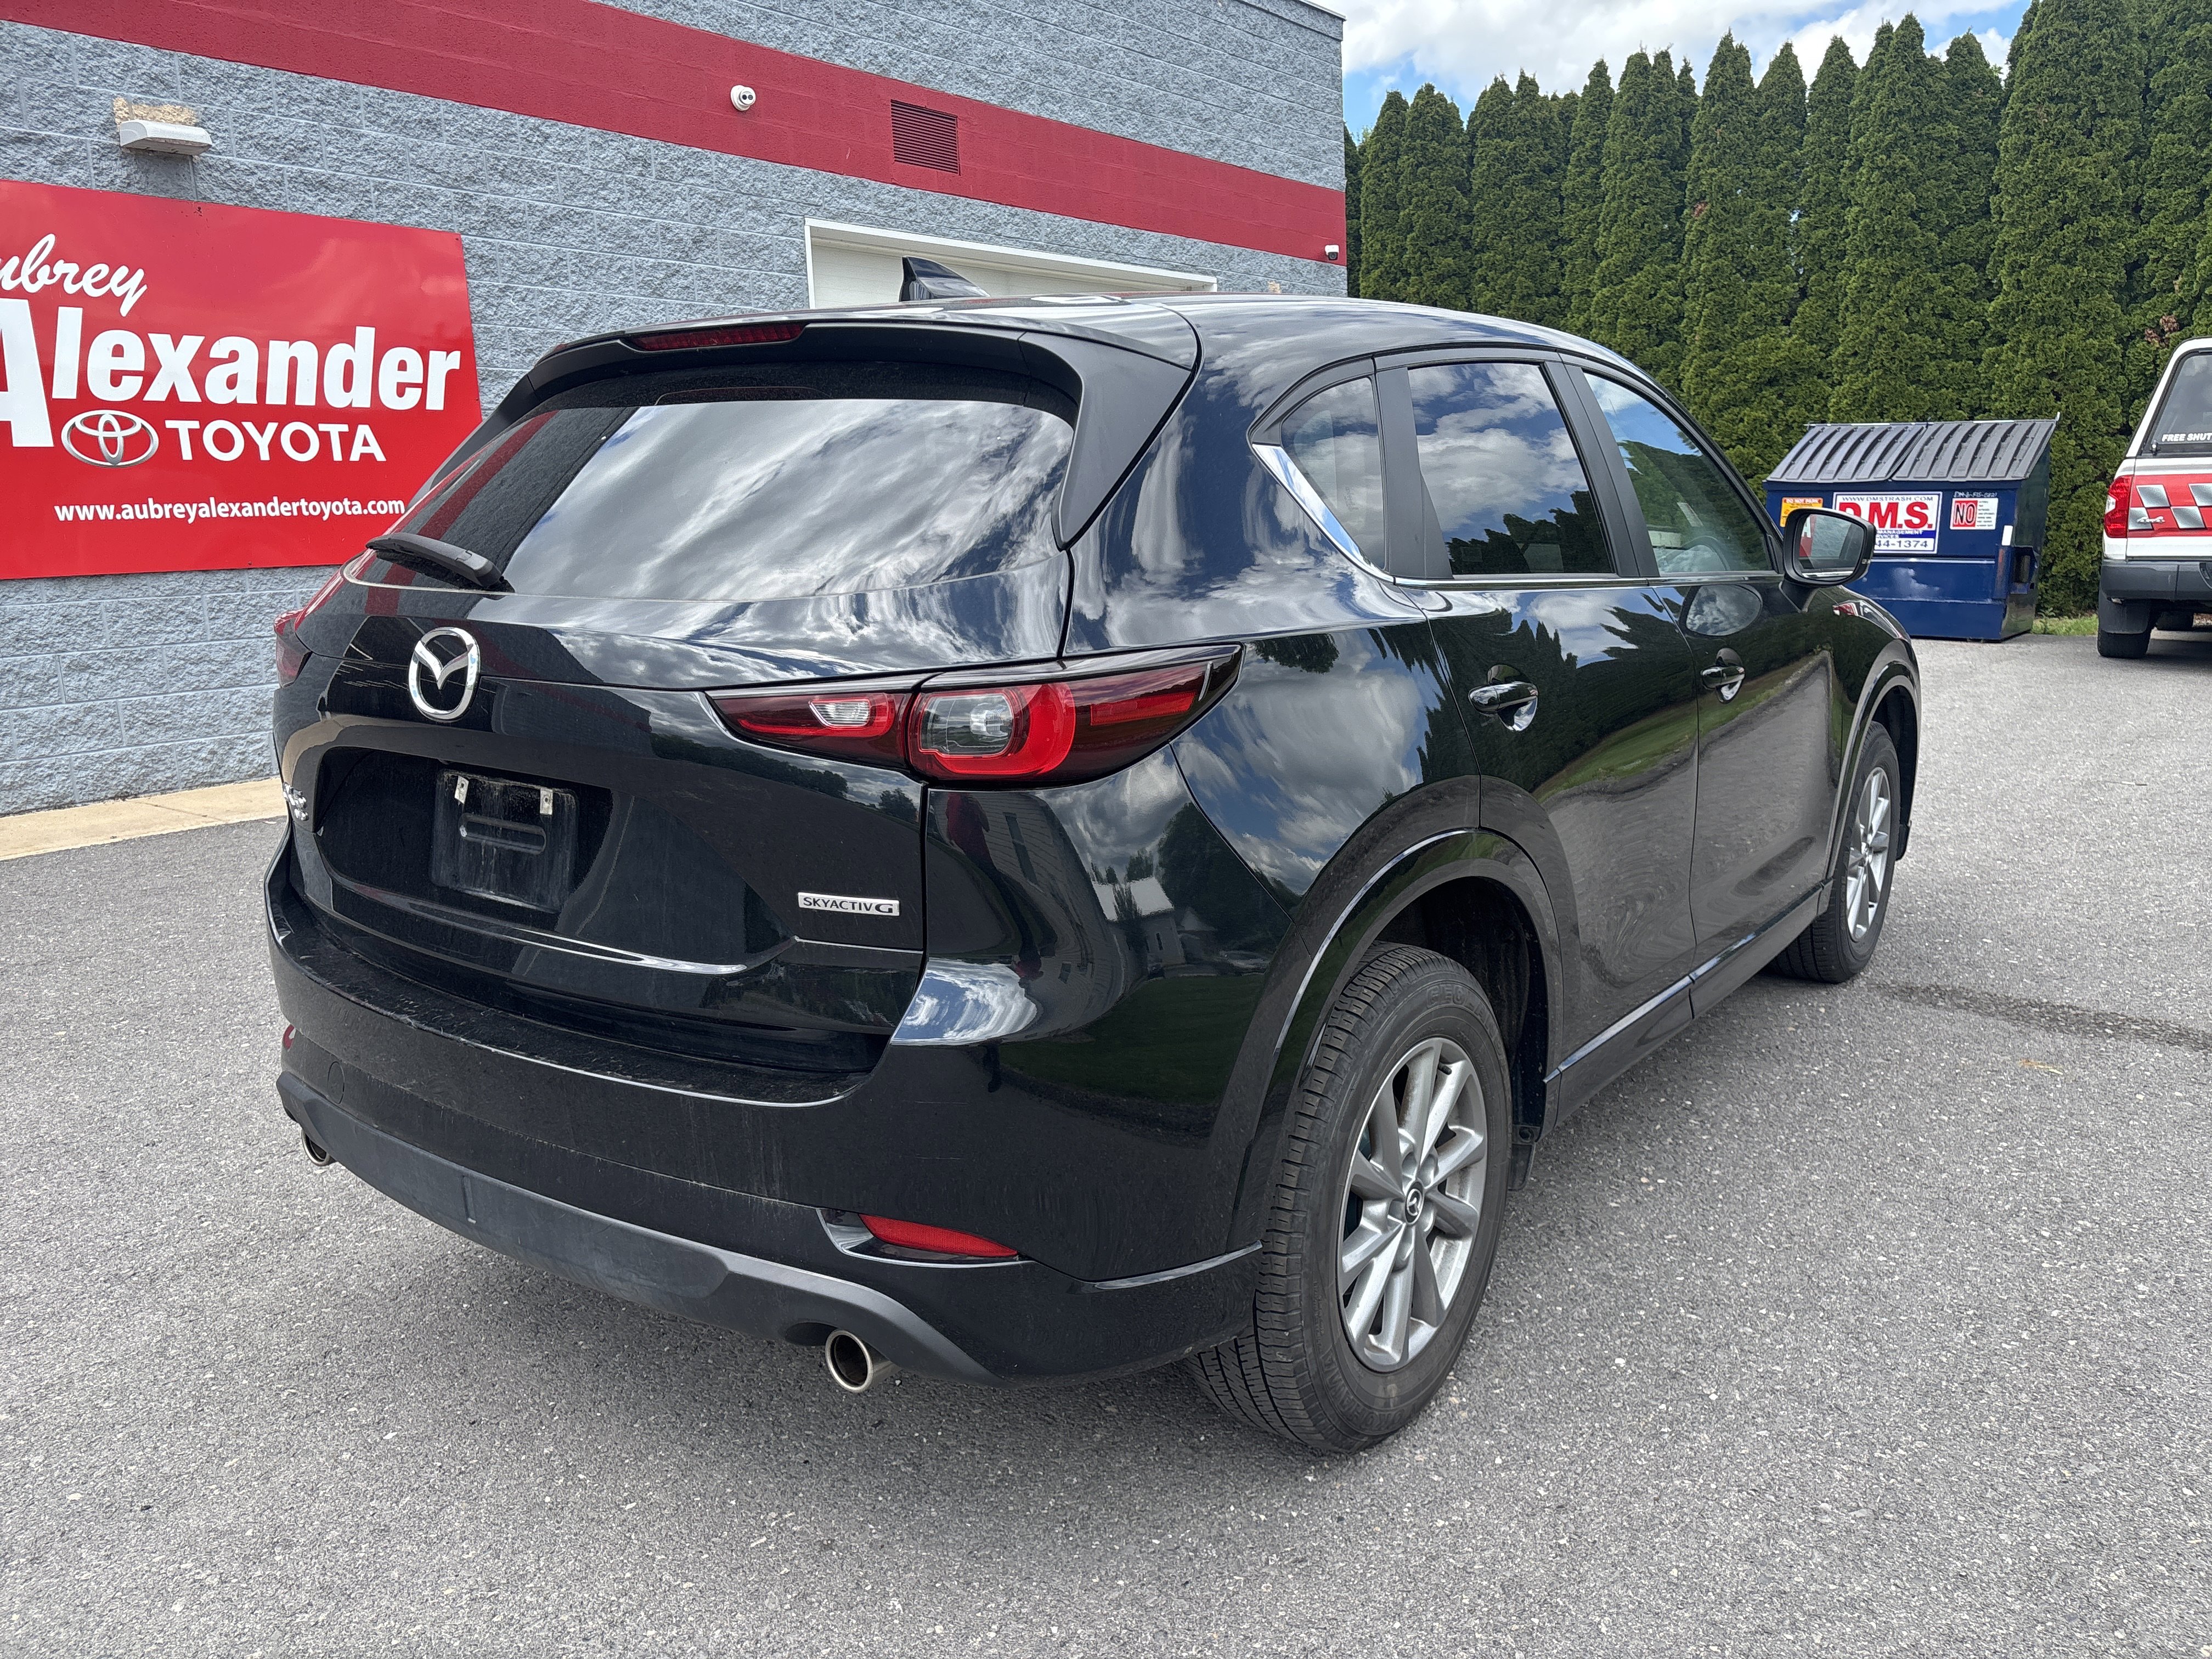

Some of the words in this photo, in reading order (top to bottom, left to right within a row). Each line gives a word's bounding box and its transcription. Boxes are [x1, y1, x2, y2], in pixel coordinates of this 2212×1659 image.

[0, 298, 461, 447] Alexander
[166, 419, 386, 461] TOYOTA
[2162, 433, 2186, 442] FREE
[54, 496, 405, 524] www.aubreyalexandertoyota.com
[1839, 501, 1933, 529] DM.S.
[1954, 502, 1976, 525] NO
